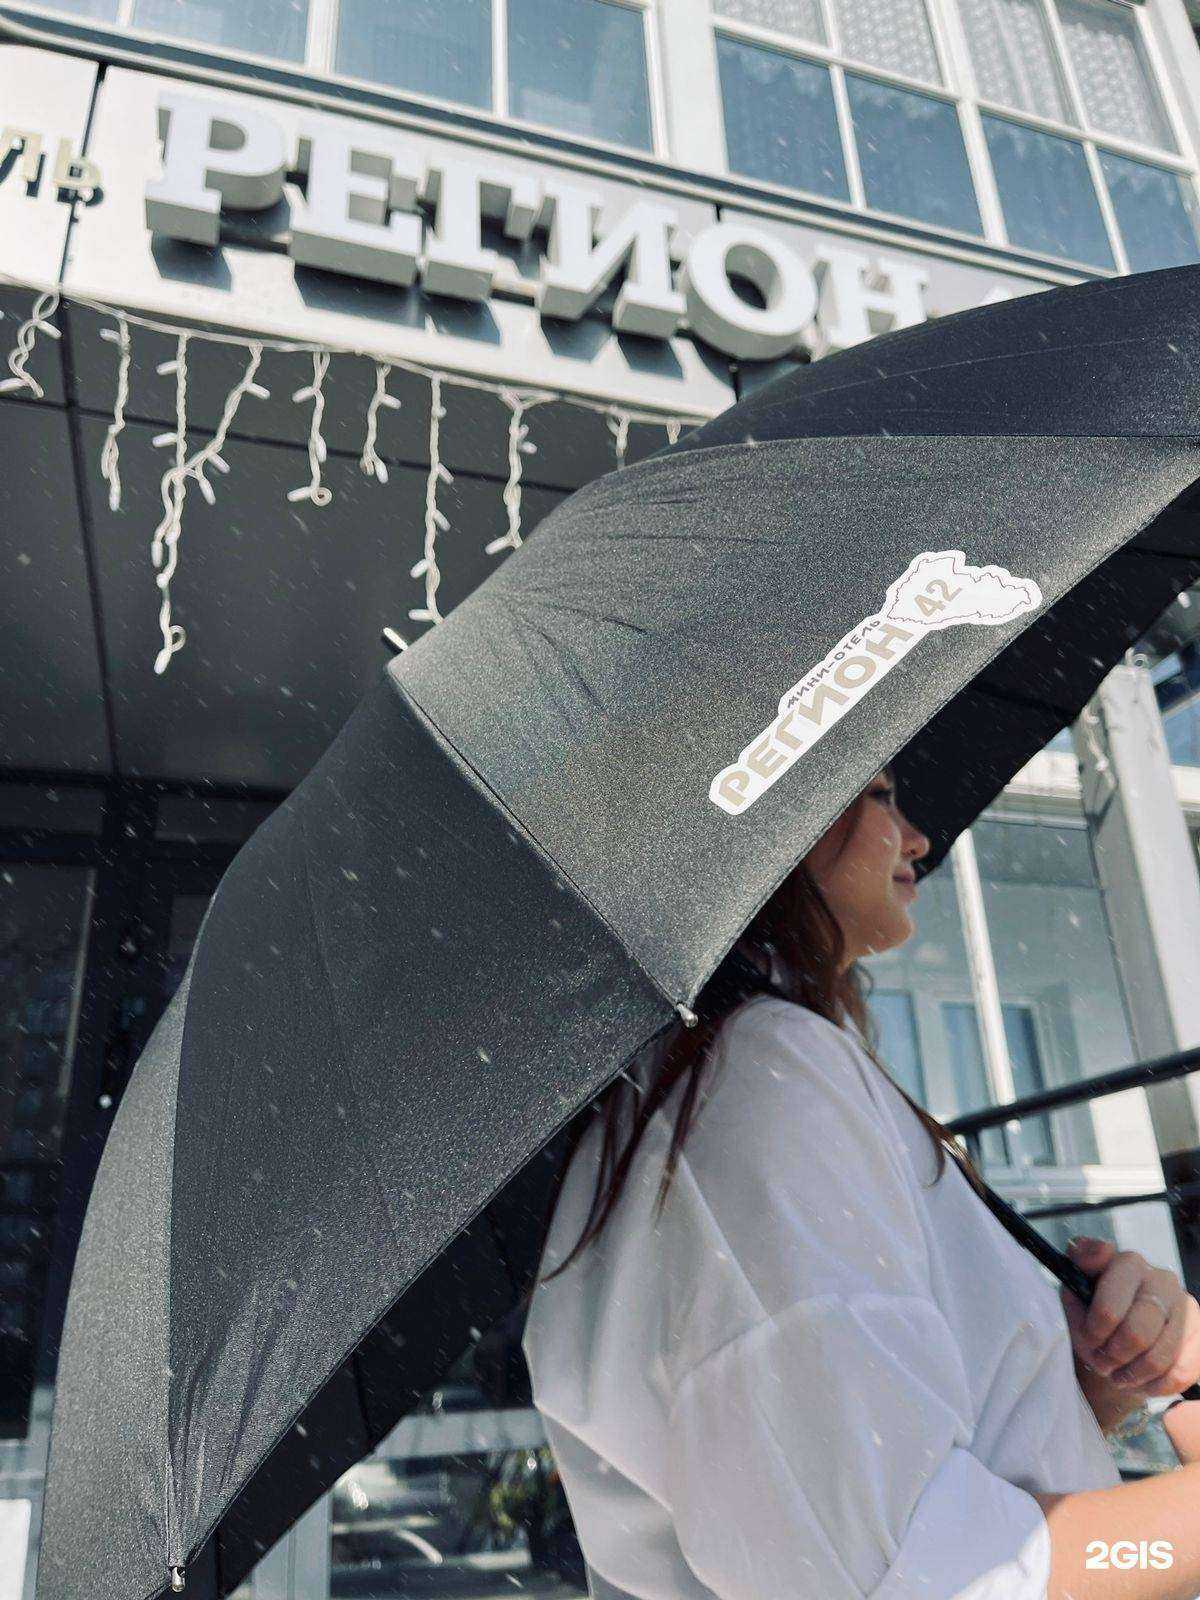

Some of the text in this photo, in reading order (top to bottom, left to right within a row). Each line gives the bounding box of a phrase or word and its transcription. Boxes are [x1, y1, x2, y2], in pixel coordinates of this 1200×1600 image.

[145, 91, 930, 358] РЕГИОН
[717, 578, 963, 808] РЕГИОН 42
[787, 618, 881, 709] МИНИ-ОТЕЛЬ
